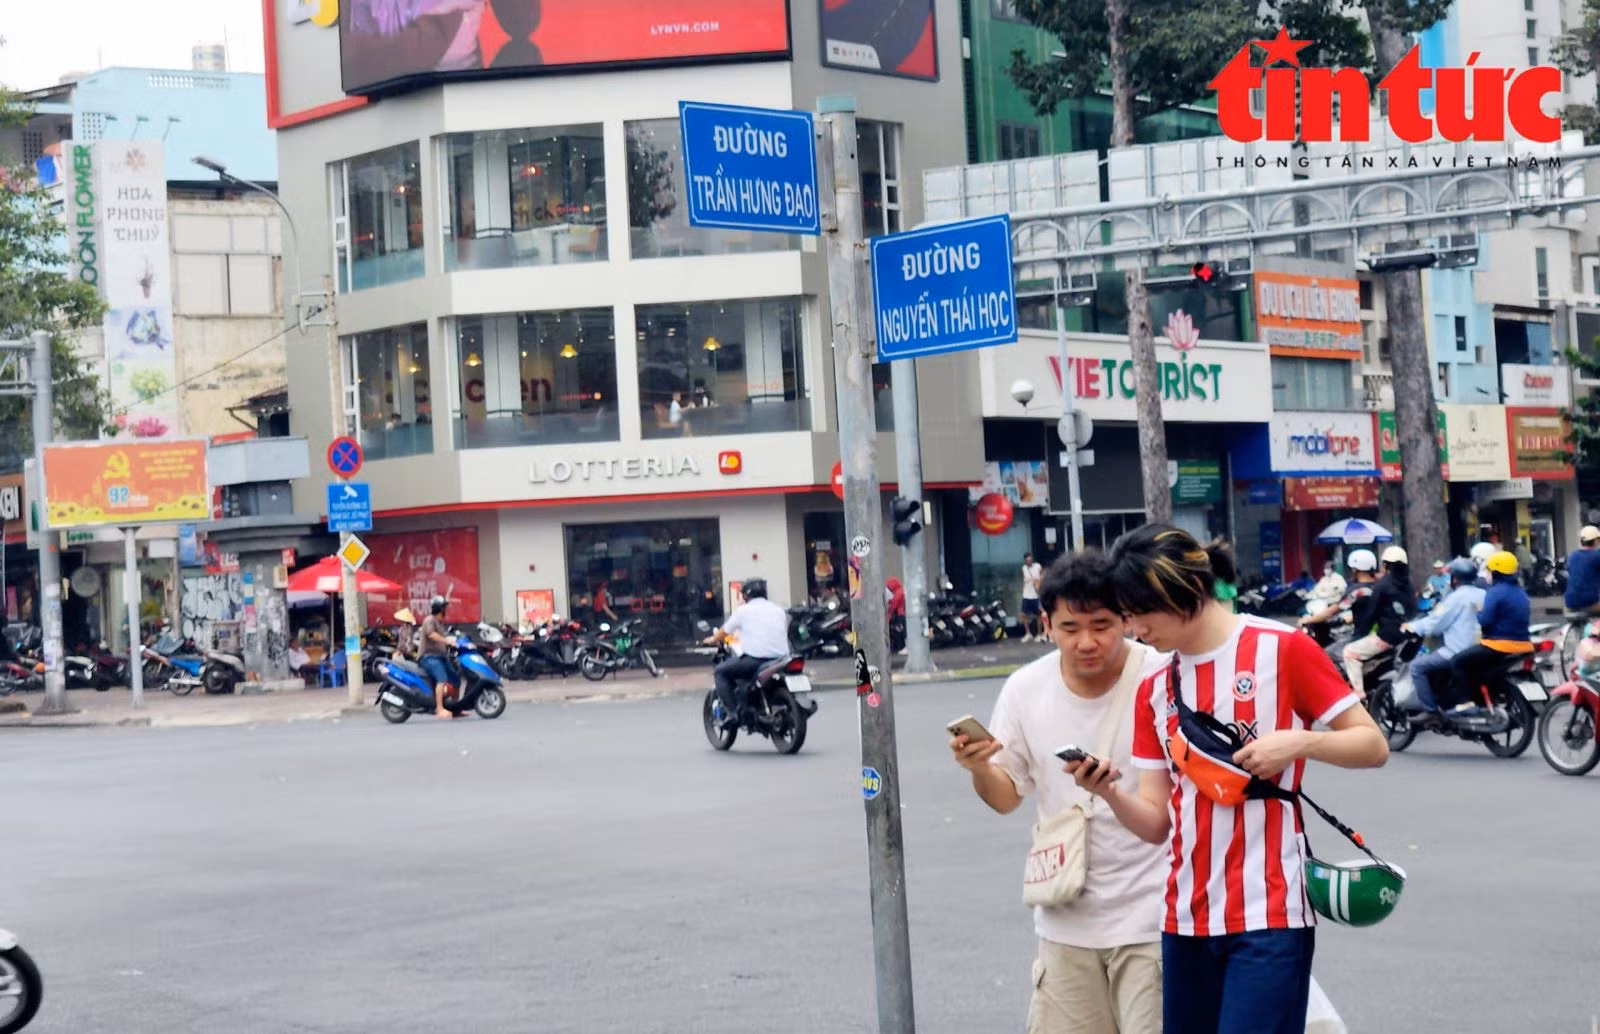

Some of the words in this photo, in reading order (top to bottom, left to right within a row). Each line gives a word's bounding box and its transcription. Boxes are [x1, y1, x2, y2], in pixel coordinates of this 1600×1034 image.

[713, 121, 788, 158] ĐƯỜNG
[74, 145, 95, 228] FLOWER
[117, 187, 152, 200] HOA
[693, 163, 738, 213] TRẦN
[739, 176, 782, 216] HƯNG
[784, 181, 814, 224] ĐẠO
[107, 207, 165, 221] PHONG
[78, 230, 97, 286] OON
[902, 242, 981, 281] ĐƯỜNG
[882, 291, 939, 344] NGUYỄN
[940, 286, 976, 335] THÁI
[978, 290, 1010, 335] HỌC
[528, 454, 701, 485] LOTTERIA
[407, 580, 437, 598] HAVE
